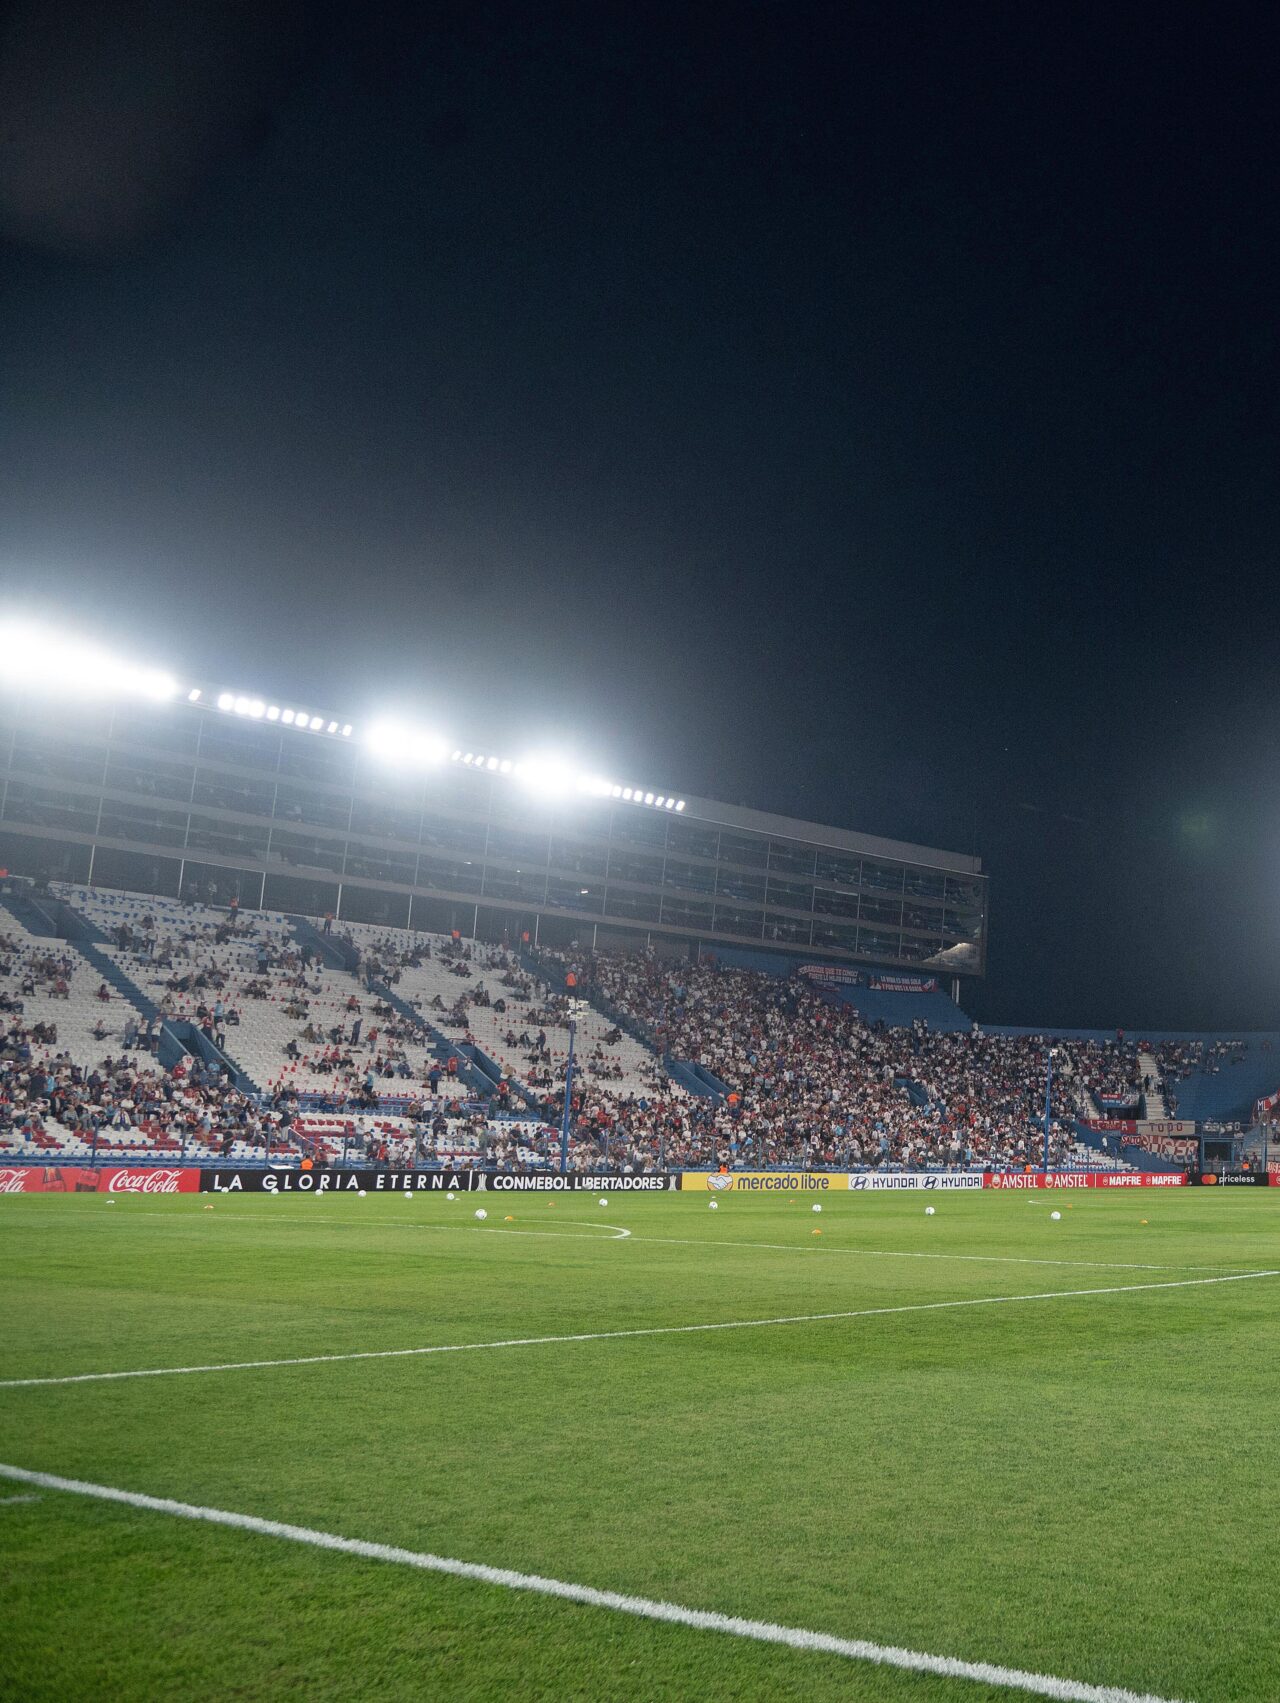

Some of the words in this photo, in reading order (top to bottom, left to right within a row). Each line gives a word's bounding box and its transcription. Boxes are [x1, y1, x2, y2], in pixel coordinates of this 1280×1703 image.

[1150, 1122, 1183, 1132] TODO
[109, 1169, 184, 1192] Coca-Cola
[214, 1174, 243, 1190] LA
[262, 1174, 359, 1190] GLORIA
[376, 1174, 461, 1190] ETERNA
[493, 1176, 571, 1190] CONMEBOL
[574, 1176, 664, 1190] LIBERTADORES
[737, 1174, 799, 1190] mercado
[801, 1174, 829, 1190] libre
[872, 1177, 918, 1188] HYUNDAI
[941, 1176, 983, 1188] HYUNDAI
[1002, 1174, 1038, 1189] AMSTEL
[1054, 1173, 1088, 1188] AMSTEL
[1109, 1175, 1141, 1186] MAPFRE
[1151, 1175, 1182, 1186] MAPFRE
[1218, 1175, 1255, 1186] priceless
